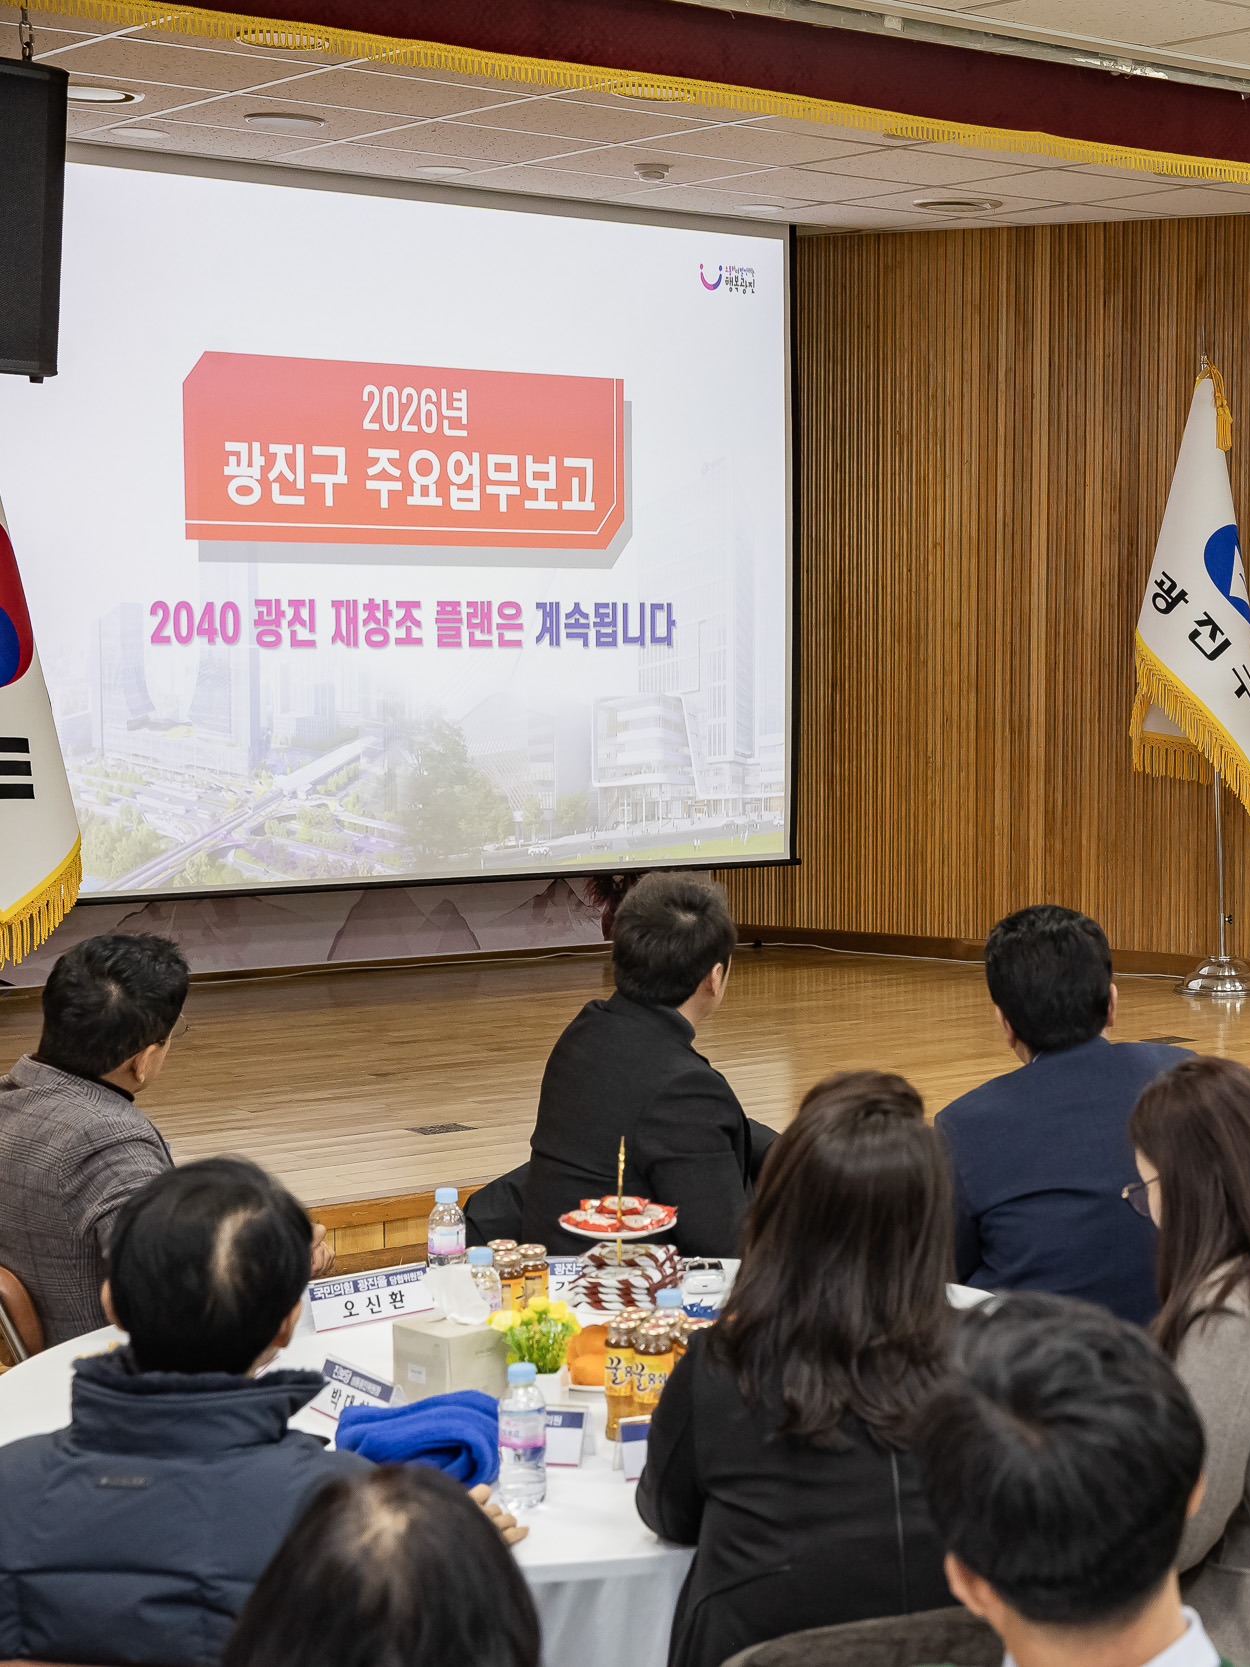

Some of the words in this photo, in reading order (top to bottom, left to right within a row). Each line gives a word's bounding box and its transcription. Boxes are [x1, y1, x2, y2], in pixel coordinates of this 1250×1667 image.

[724, 275, 756, 295] 행복광진
[362, 385, 469, 437] 2026년
[223, 441, 348, 507] 광진구
[365, 448, 596, 513] 주요업무보고
[150, 600, 240, 644] 2040
[253, 598, 317, 649] 광진
[331, 598, 423, 649] 재창조
[435, 600, 524, 649] 플랜은
[535, 601, 676, 648] 계속됩니다
[313, 1281, 355, 1300] 국민의힘
[357, 1275, 388, 1293] 광진을
[389, 1270, 425, 1285] 당협위원장
